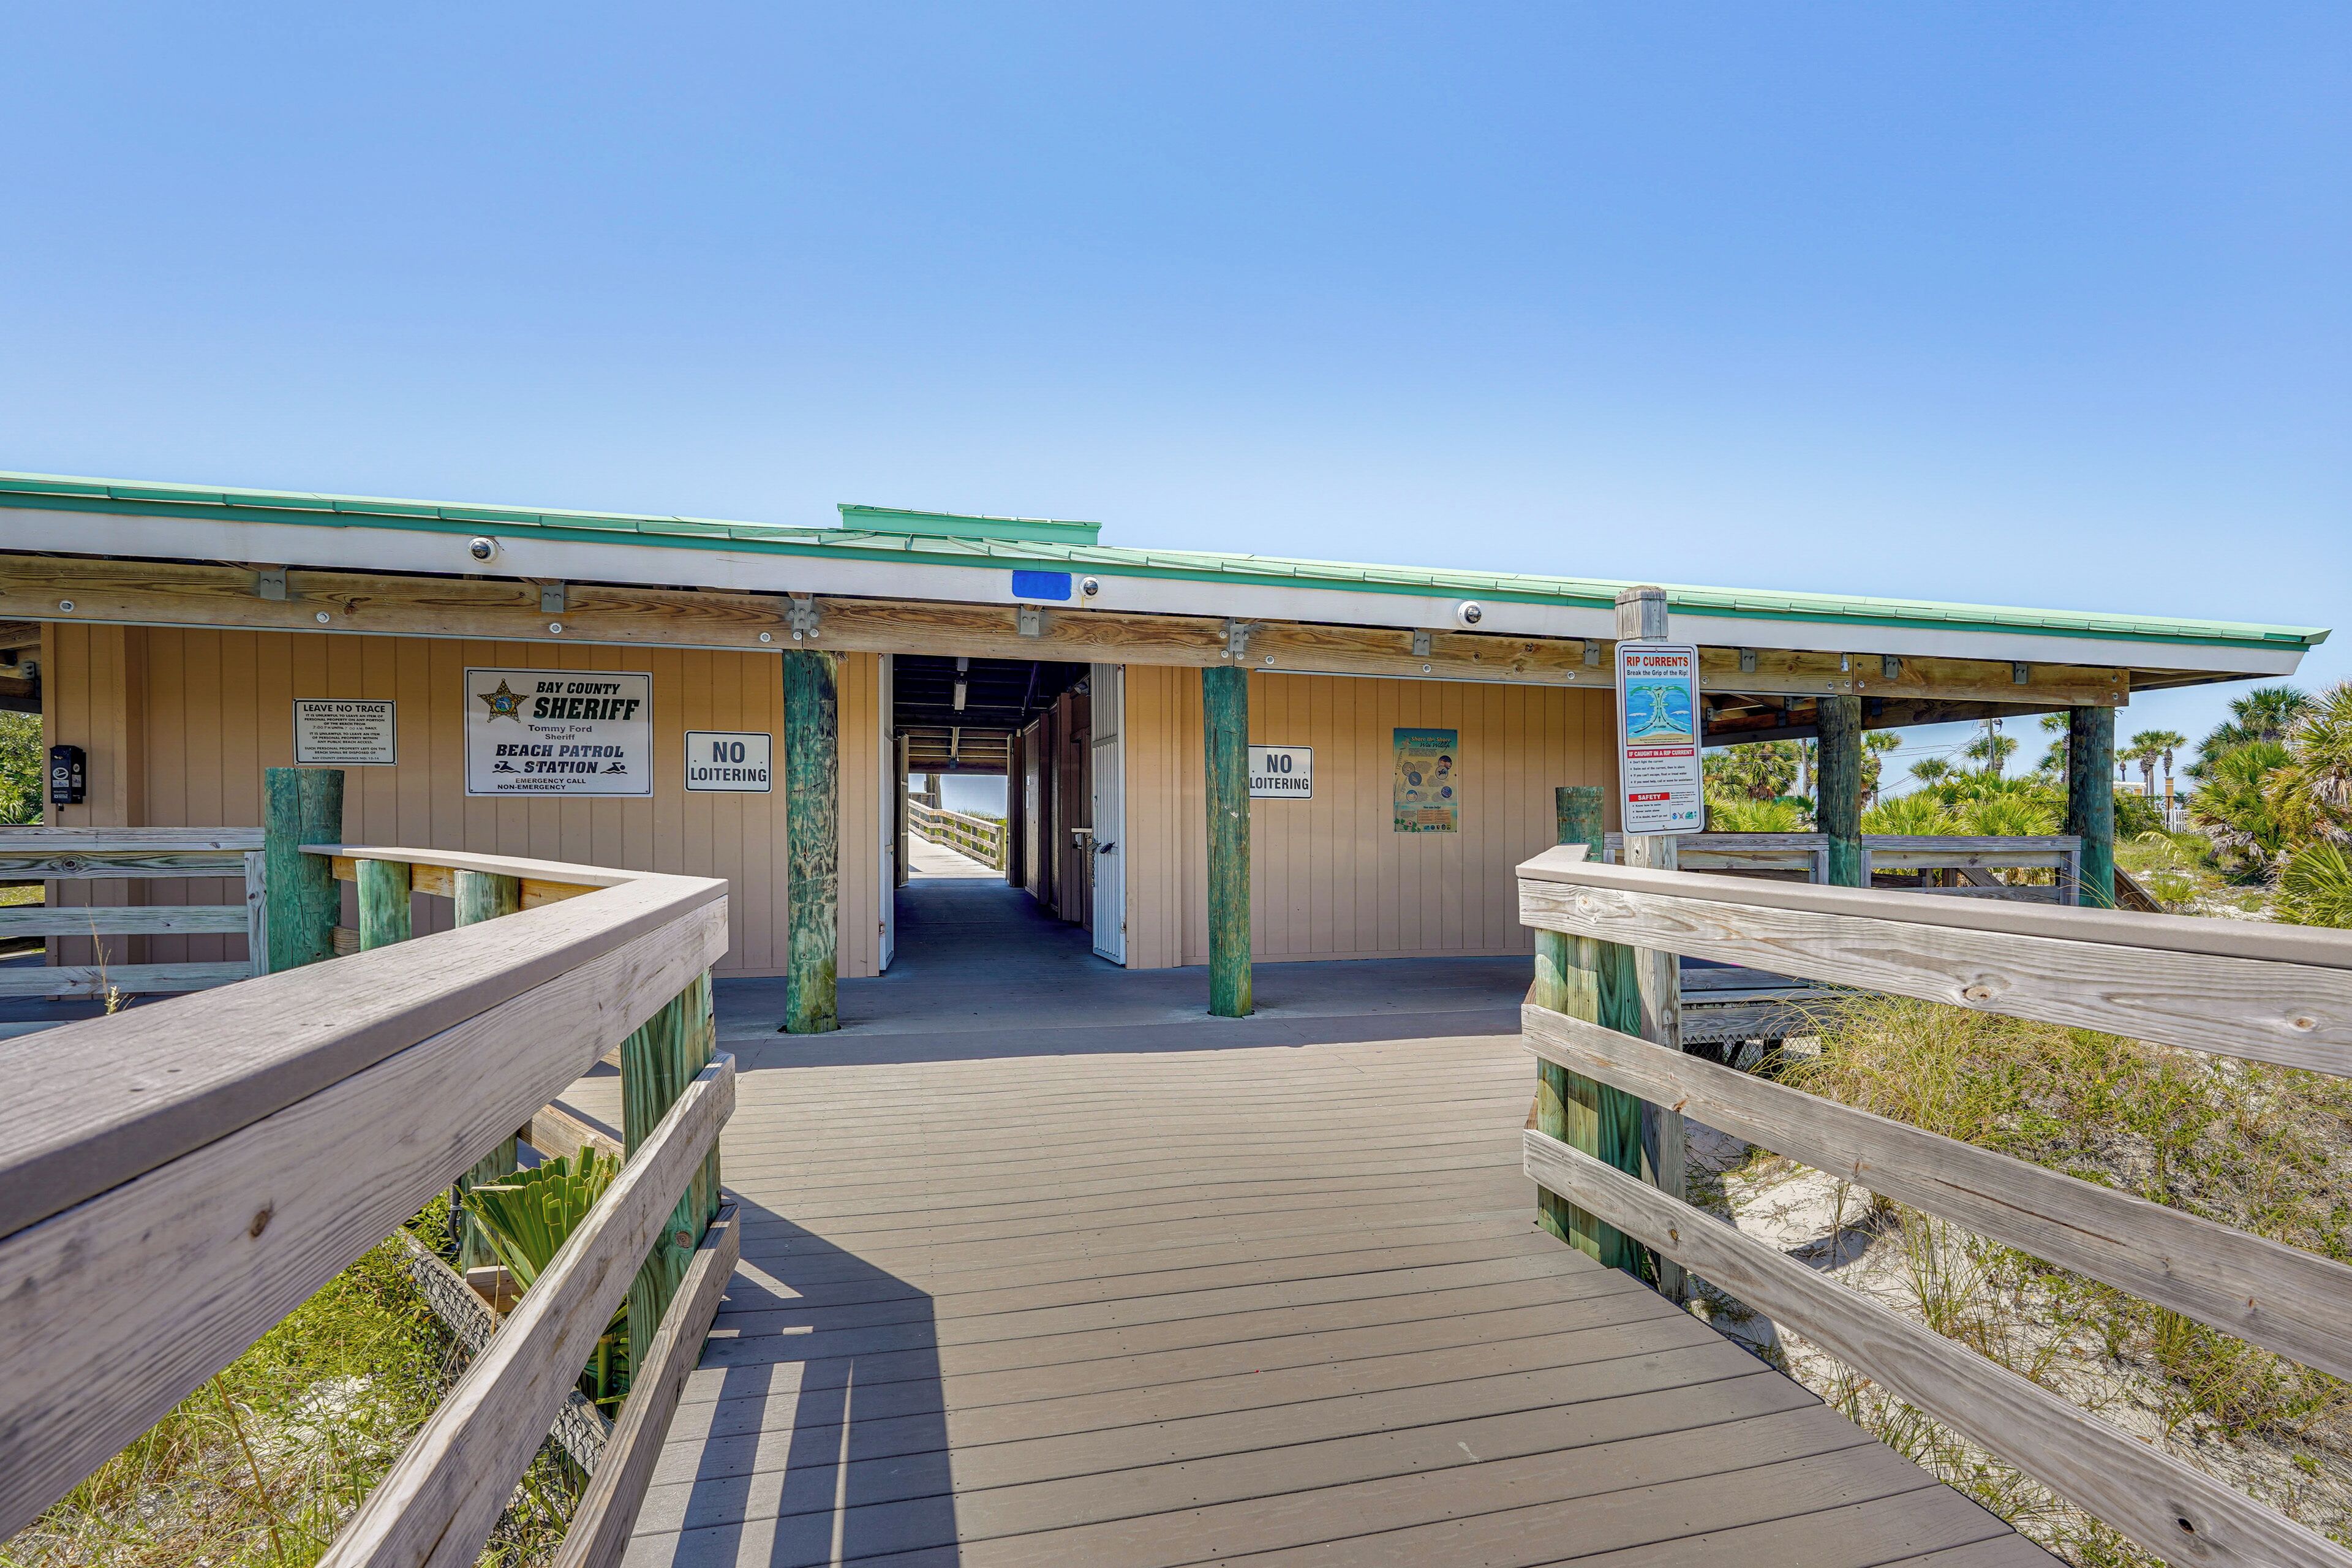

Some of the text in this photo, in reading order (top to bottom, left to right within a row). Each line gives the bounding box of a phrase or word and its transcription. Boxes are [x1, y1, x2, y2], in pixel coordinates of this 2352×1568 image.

[1626, 656, 1688, 666] RIP CURRENTS
[536, 682, 620, 695] BAY COUNTY
[533, 697, 640, 720] SHERIFF
[528, 725, 565, 734] Tommy
[496, 744, 624, 758] BEACH PATROL
[713, 742, 745, 763] NO
[524, 761, 598, 774] STATION
[1267, 755, 1292, 773] NO
[691, 767, 766, 782] LOITERING
[1250, 777, 1308, 790] LOITERING
